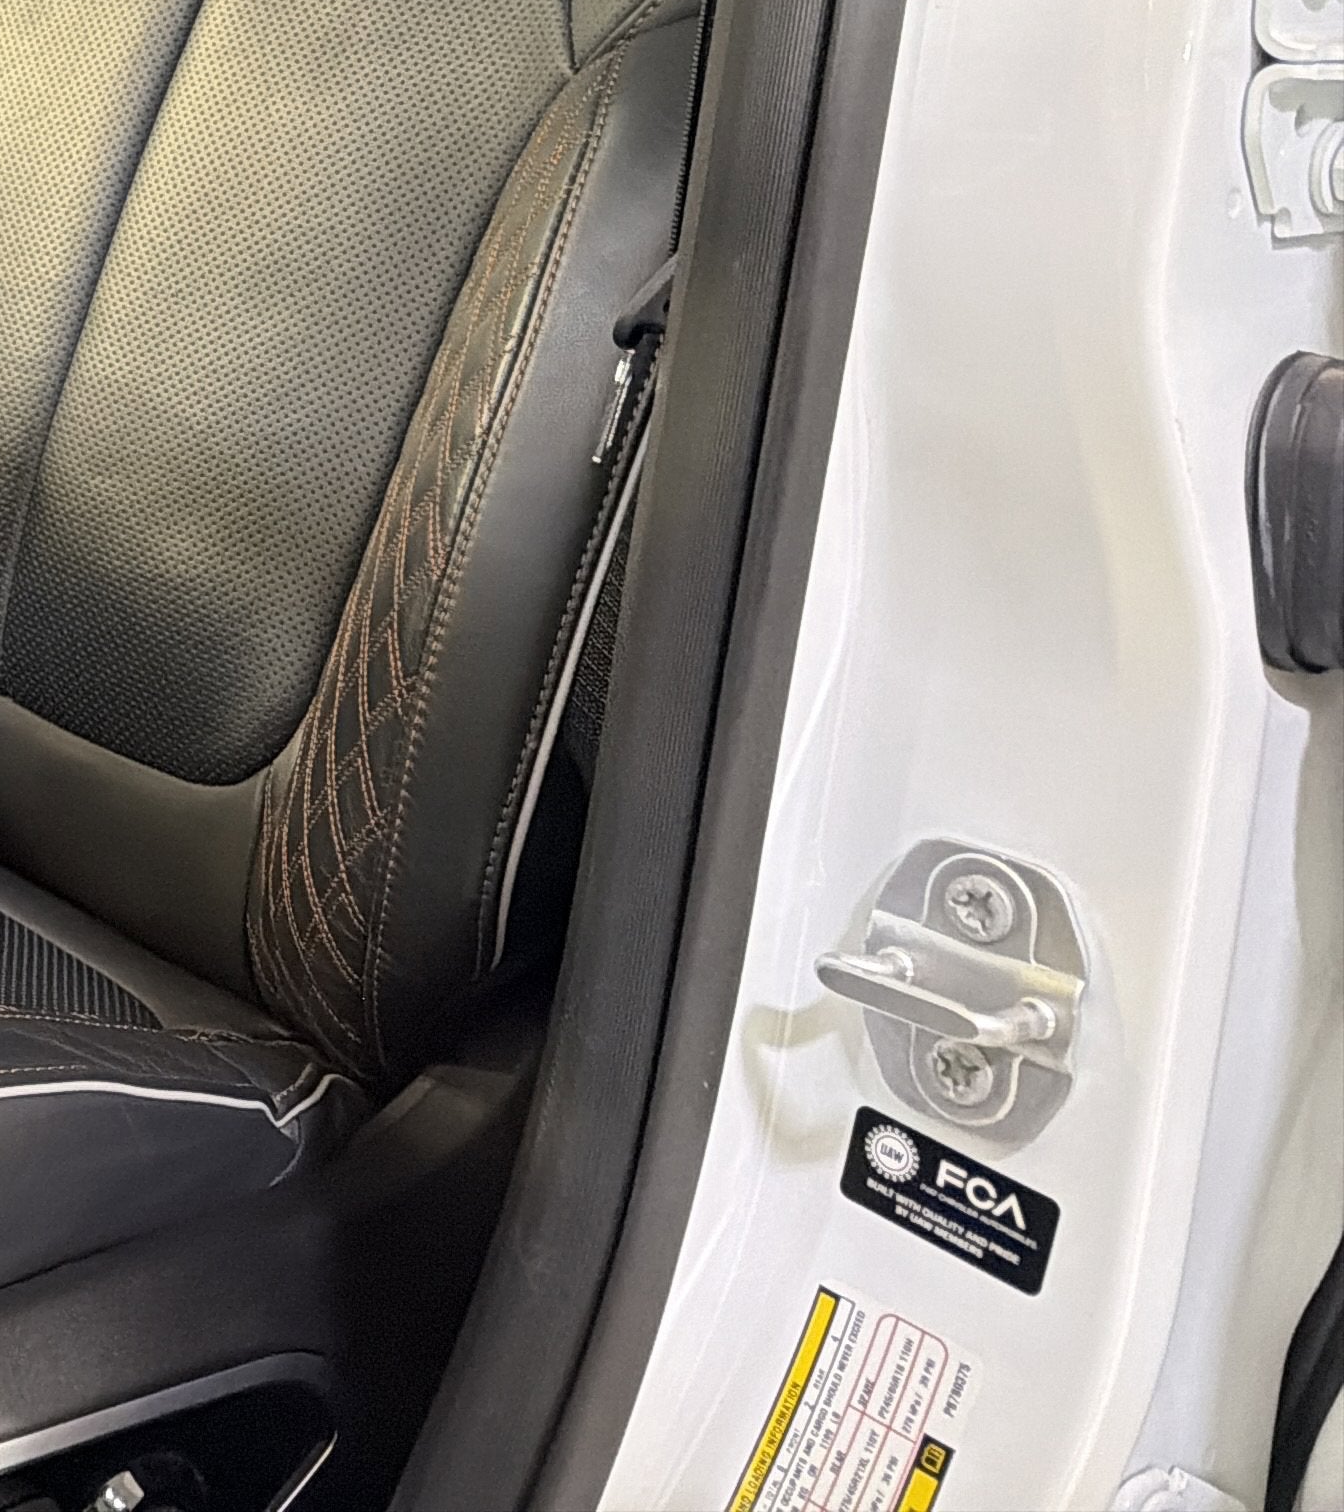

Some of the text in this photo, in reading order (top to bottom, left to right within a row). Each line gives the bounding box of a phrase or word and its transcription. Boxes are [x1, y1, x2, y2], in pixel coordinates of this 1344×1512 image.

[895, 1191, 922, 1213] WITH
[921, 1206, 965, 1235] QUALITY
[936, 1159, 1028, 1230] FCA
[745, 1450, 771, 1495] LOADING
[766, 1381, 801, 1451] INFORMATION
[780, 1457, 808, 1507] OCCUPANTS
[810, 1407, 829, 1438] CARGO
[836, 1344, 854, 1375] NEVER
[850, 1310, 866, 1344] EXCEED
